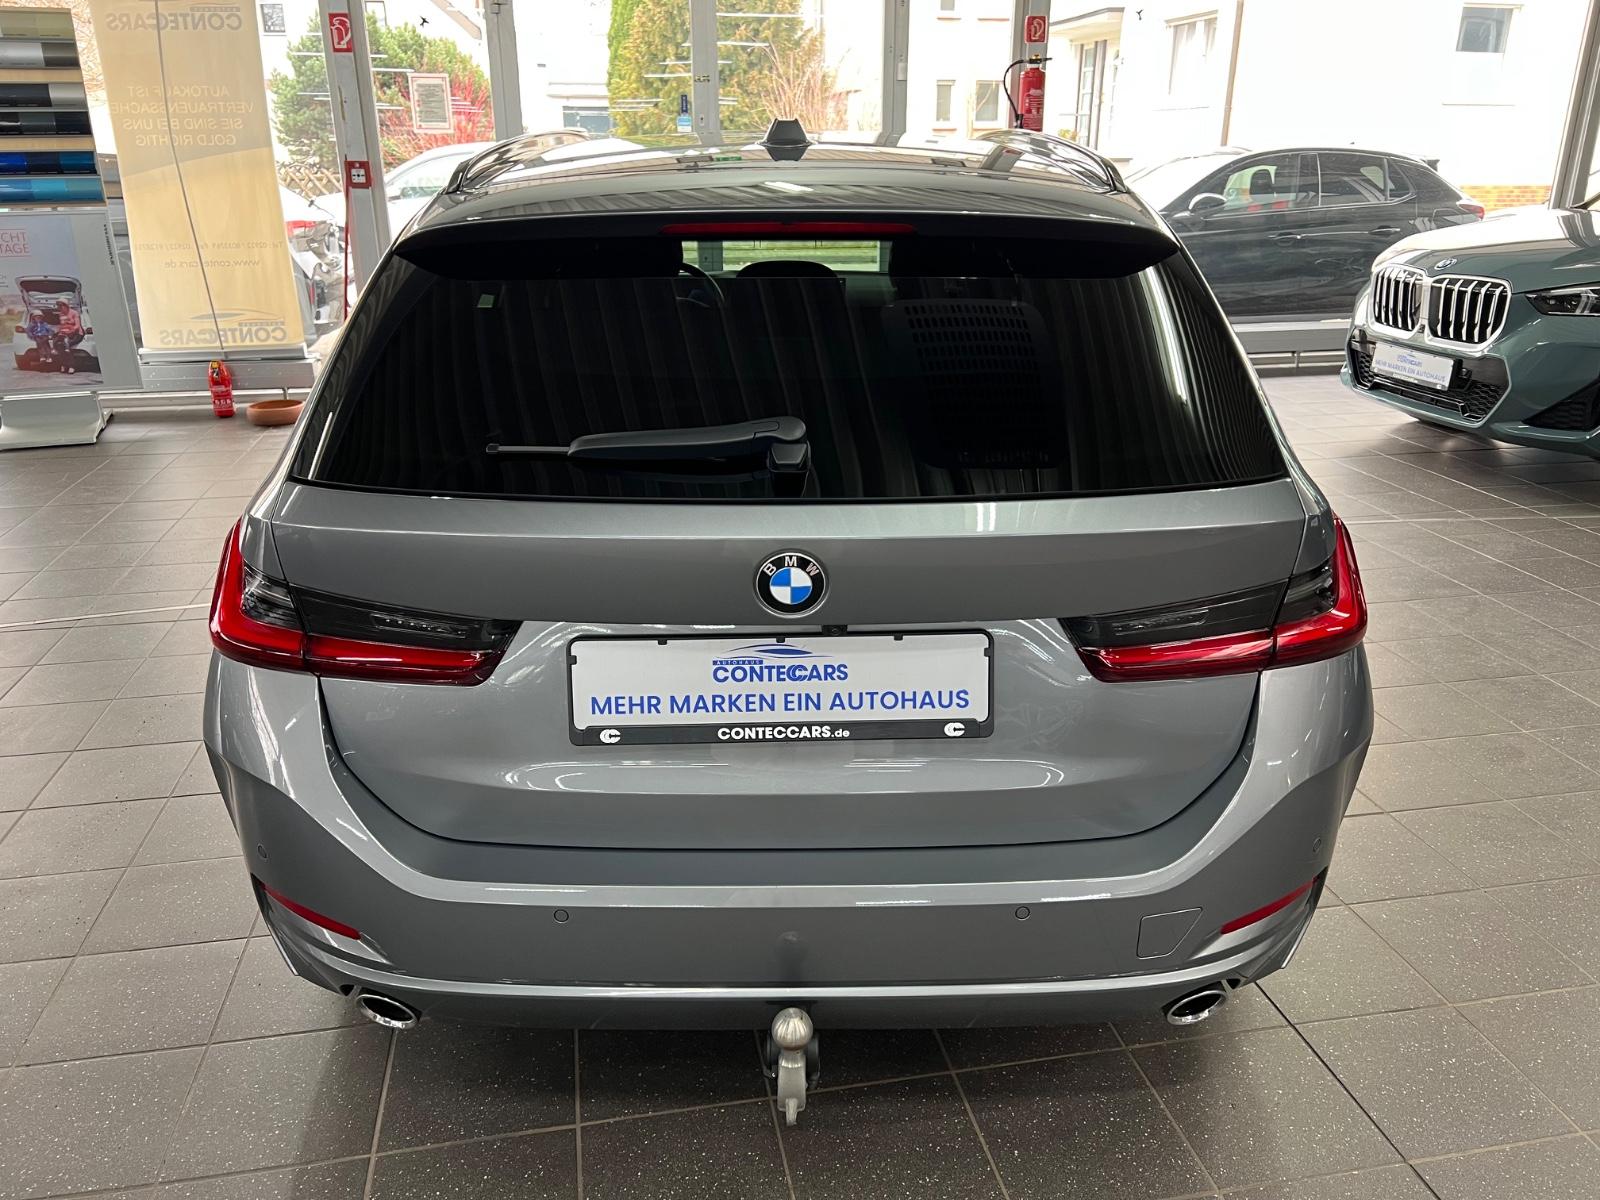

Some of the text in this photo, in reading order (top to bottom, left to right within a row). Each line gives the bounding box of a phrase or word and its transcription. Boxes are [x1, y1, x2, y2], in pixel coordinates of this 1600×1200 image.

[763, 555, 820, 577] BMW
[591, 689, 970, 715] MEHR MARKEN EIN AUTOHAUS
[717, 725, 850, 740] CONTECCARS.de
